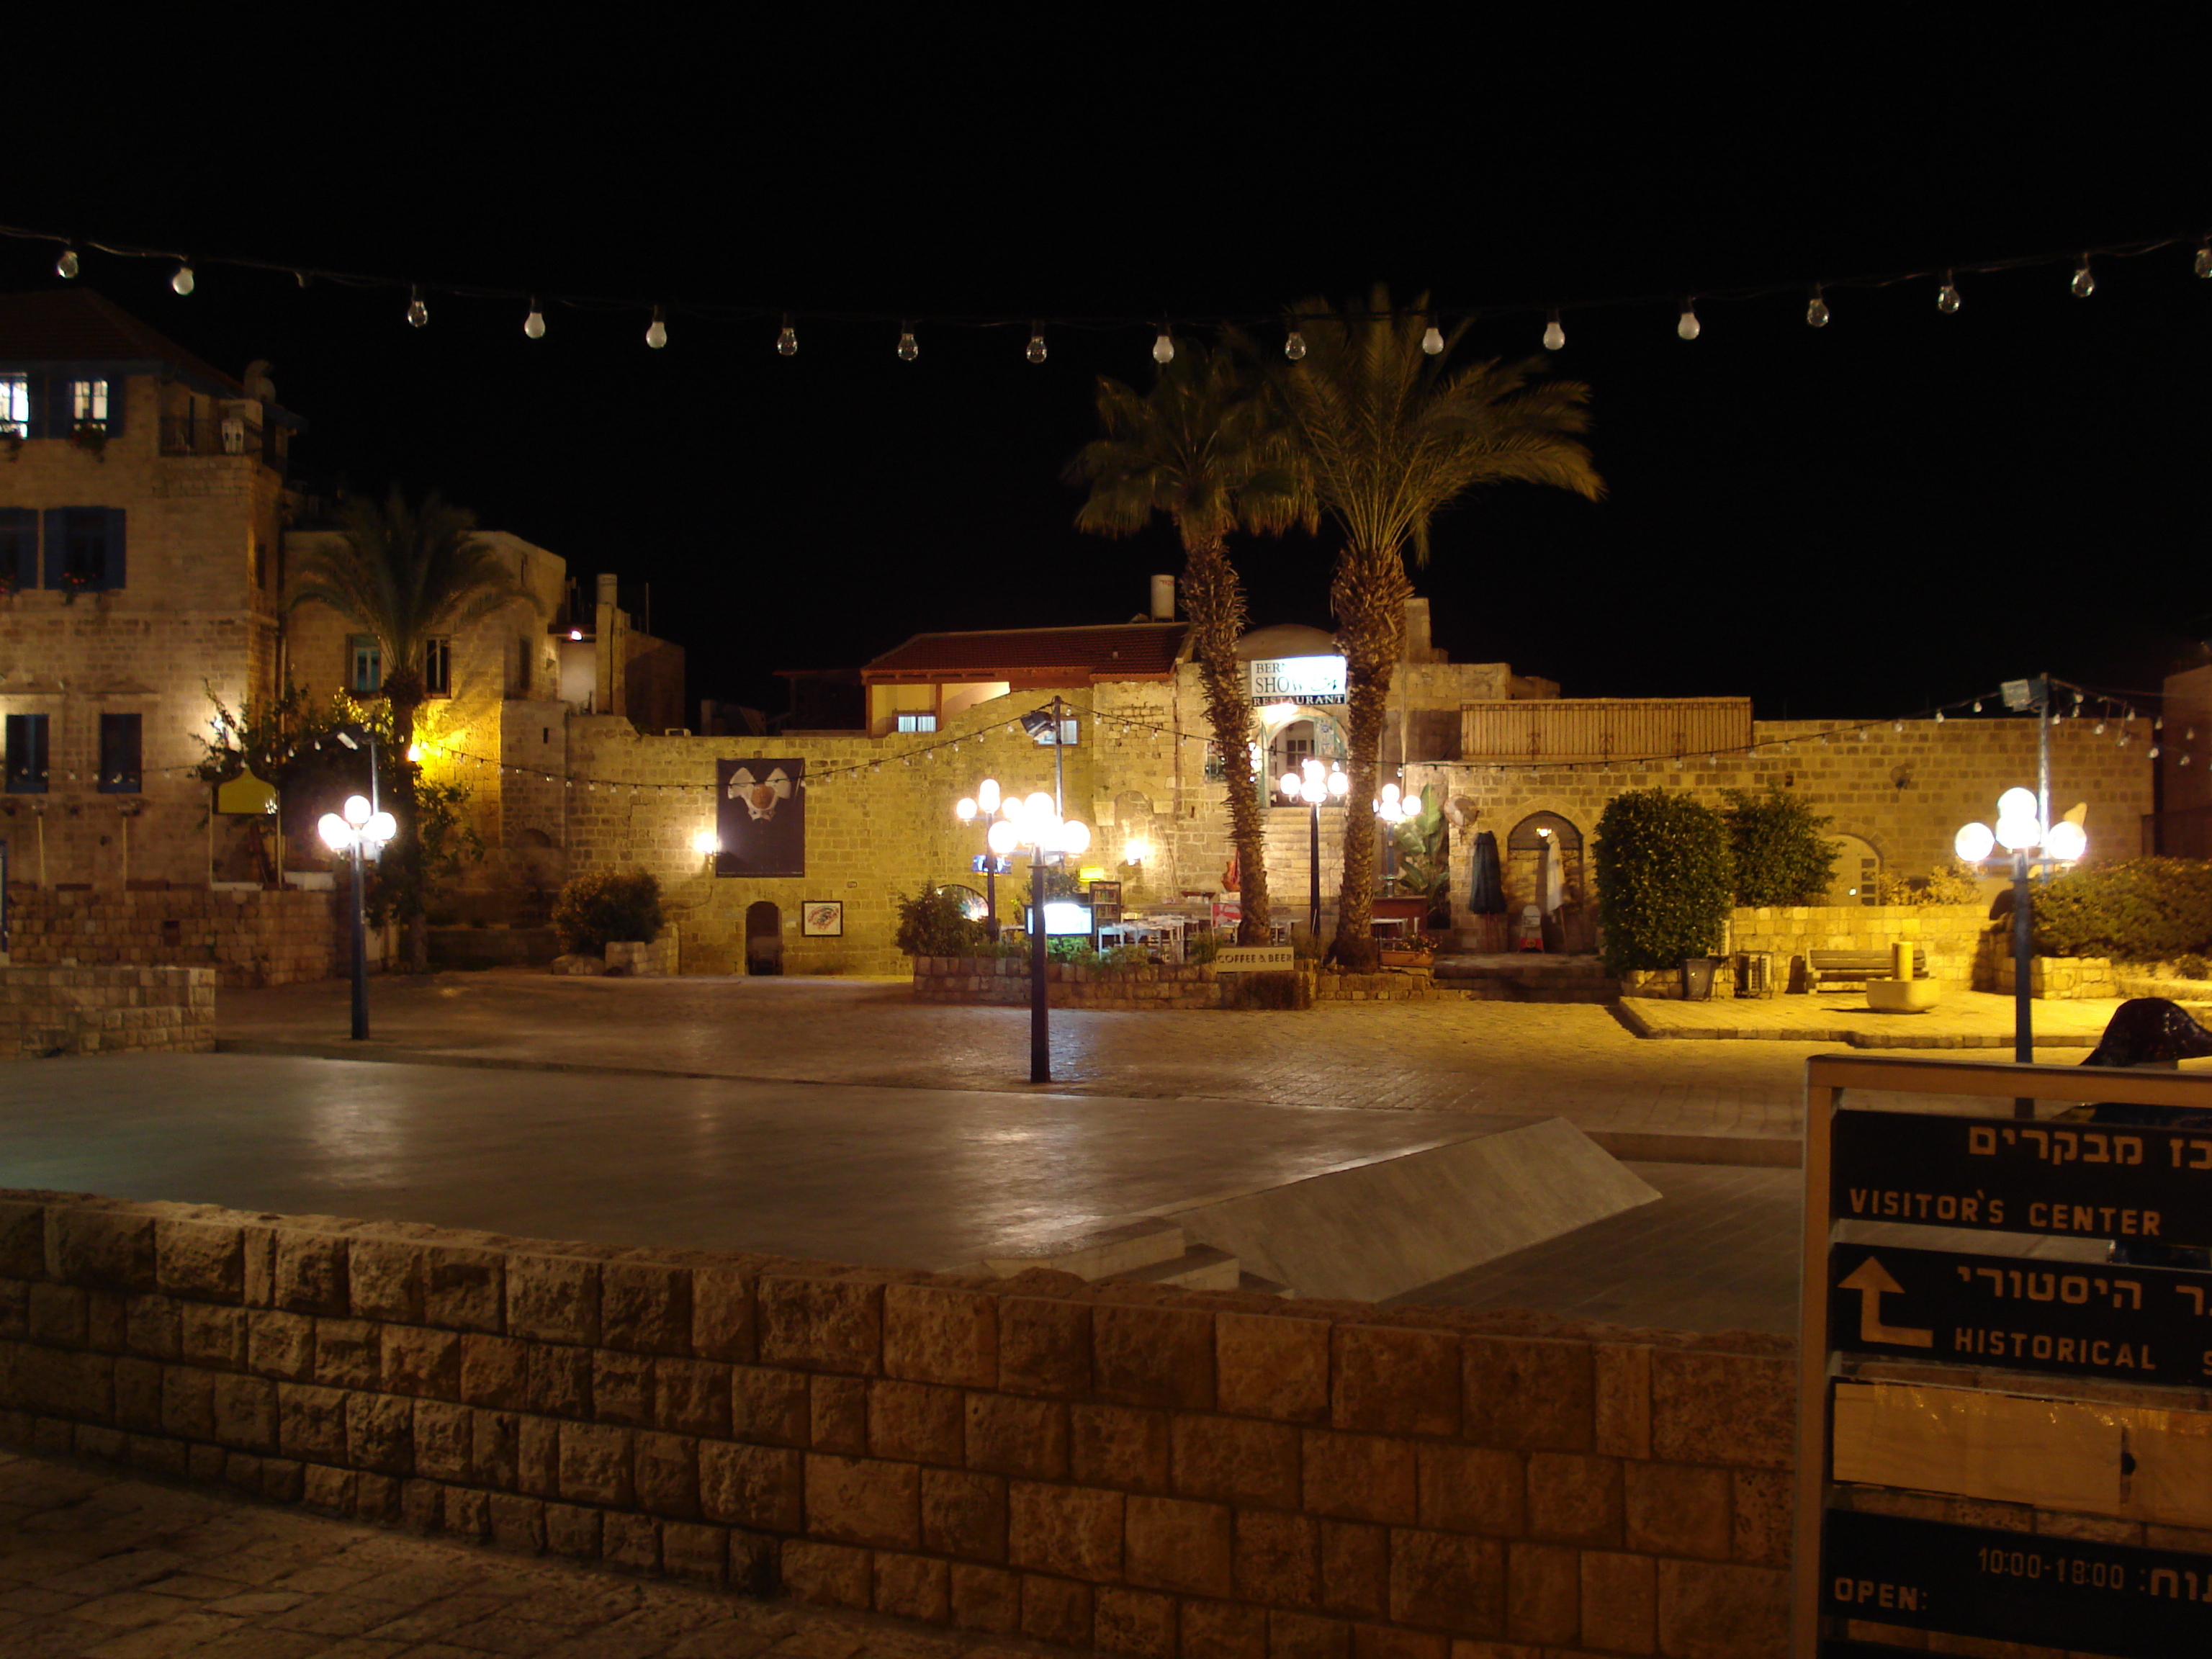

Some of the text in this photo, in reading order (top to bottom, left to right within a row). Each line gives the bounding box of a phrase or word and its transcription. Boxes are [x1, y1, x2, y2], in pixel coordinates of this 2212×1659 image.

[1253, 695, 1344, 706] RESTAURANT
[1218, 953, 1292, 963] COFFEE & BEER
[1969, 1125, 2144, 1166] מבקרים
[2028, 1202, 2162, 1236] CENTER
[1956, 1265, 2143, 1310] היסטורי
[1954, 1327, 2157, 1370] HISTORICAL
[1834, 1576, 1928, 1611] OPEN:
